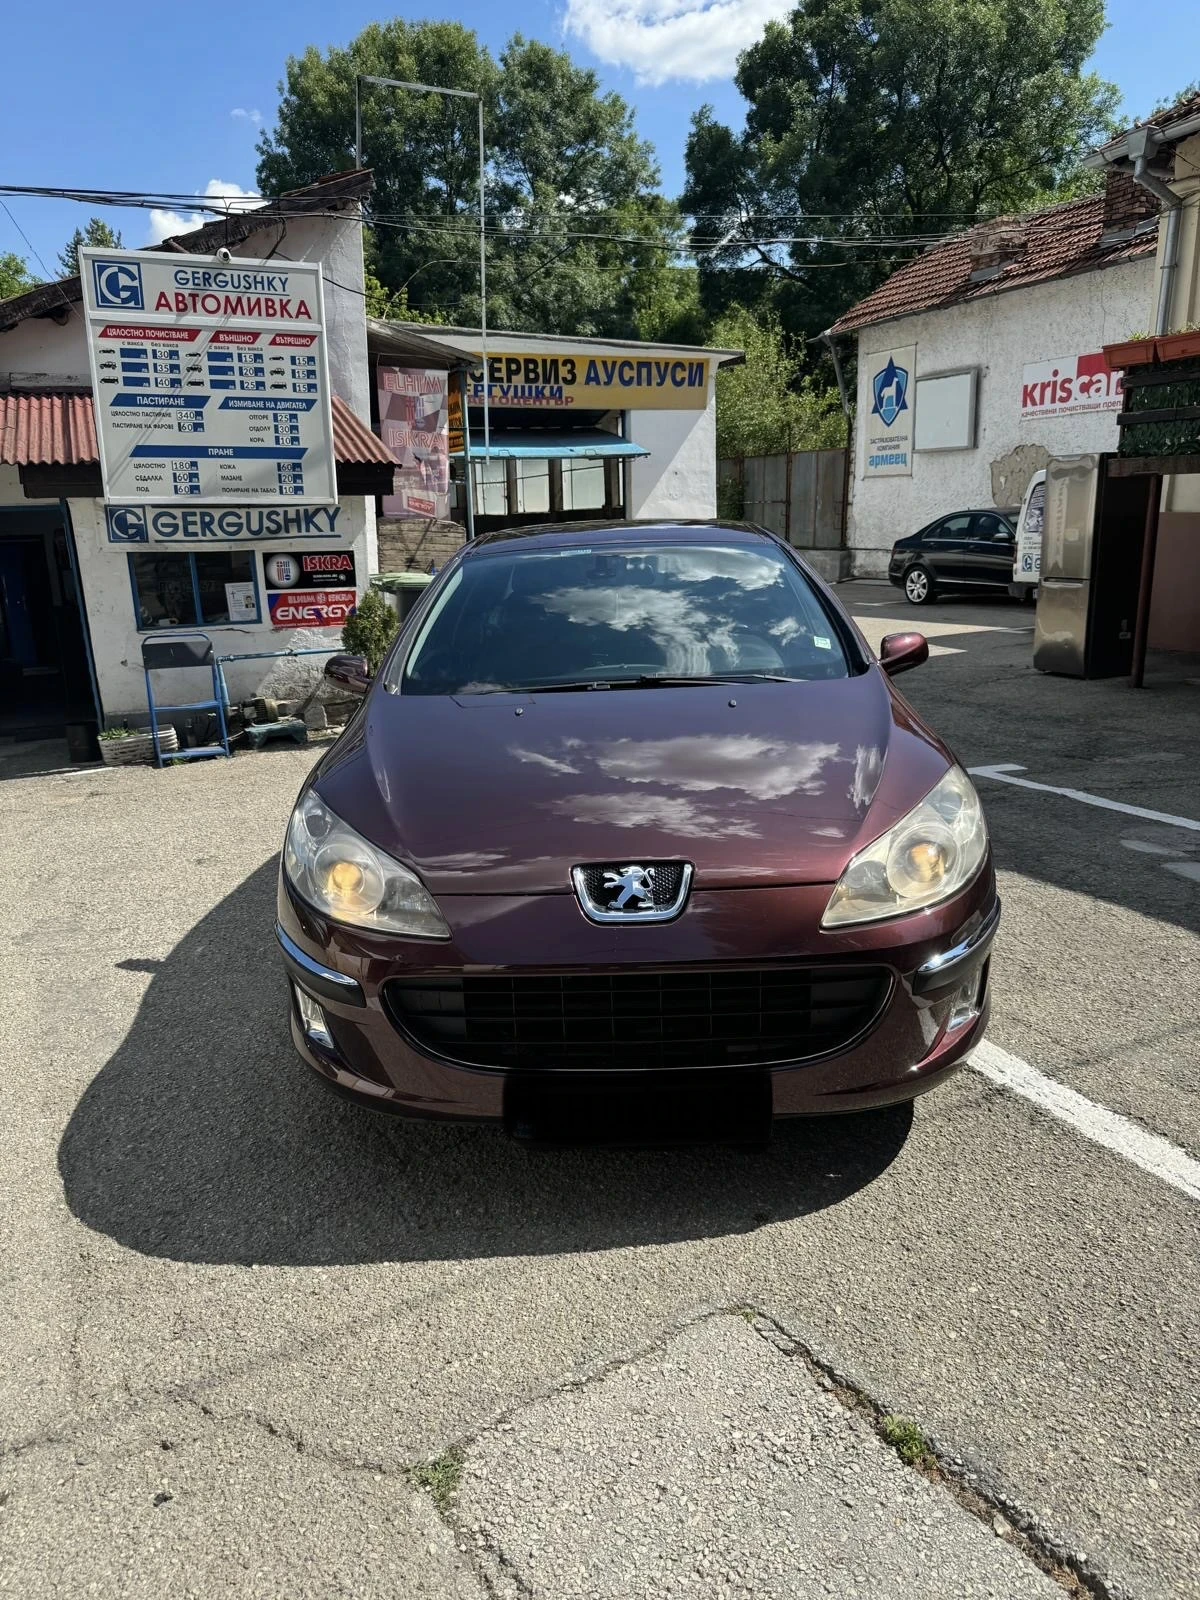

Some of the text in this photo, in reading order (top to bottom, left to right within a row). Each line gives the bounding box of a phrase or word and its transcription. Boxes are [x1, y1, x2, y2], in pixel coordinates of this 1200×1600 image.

[174, 270, 288, 292] GERGUSHKY
[155, 291, 312, 319] АВТОМИВКА
[107, 328, 189, 339] ЦЯЛОСТНО ПОЧИСТВАНЕ
[219, 333, 254, 343] ВЪНШНО
[275, 336, 311, 345] ВЪТРЕШНО
[157, 351, 169, 359] 30
[243, 354, 254, 363] 15
[297, 357, 307, 365] 15
[158, 364, 169, 373] 35
[243, 367, 254, 376] 20
[297, 370, 307, 378] 15
[584, 360, 704, 387] АУСПУСИ
[158, 378, 170, 387] 40
[244, 381, 255, 390] 25
[383, 373, 443, 393] ELHIM
[297, 384, 307, 392] 15
[467, 384, 563, 399] РГУШКИ
[136, 396, 185, 406] ПАСТИРАНЕ
[228, 400, 307, 410] ИЗМИВАНЕ НА ДВИГАТЕЛ
[1059, 403, 1101, 413] почистващи
[177, 411, 195, 420] 340
[278, 414, 289, 422] 25
[181, 423, 193, 431] 60
[279, 425, 290, 434] 30
[281, 437, 291, 445] 10
[388, 428, 445, 448] ISKRA
[208, 448, 234, 456] ПРАНЕ
[869, 453, 907, 468] армеец
[174, 461, 190, 470] 180
[281, 463, 292, 471] 60
[177, 473, 189, 481] 60
[282, 474, 293, 483] 20
[152, 507, 341, 538] GERGUSHKY
[303, 555, 353, 571] ISKRA
[276, 603, 354, 620] ENERGY
